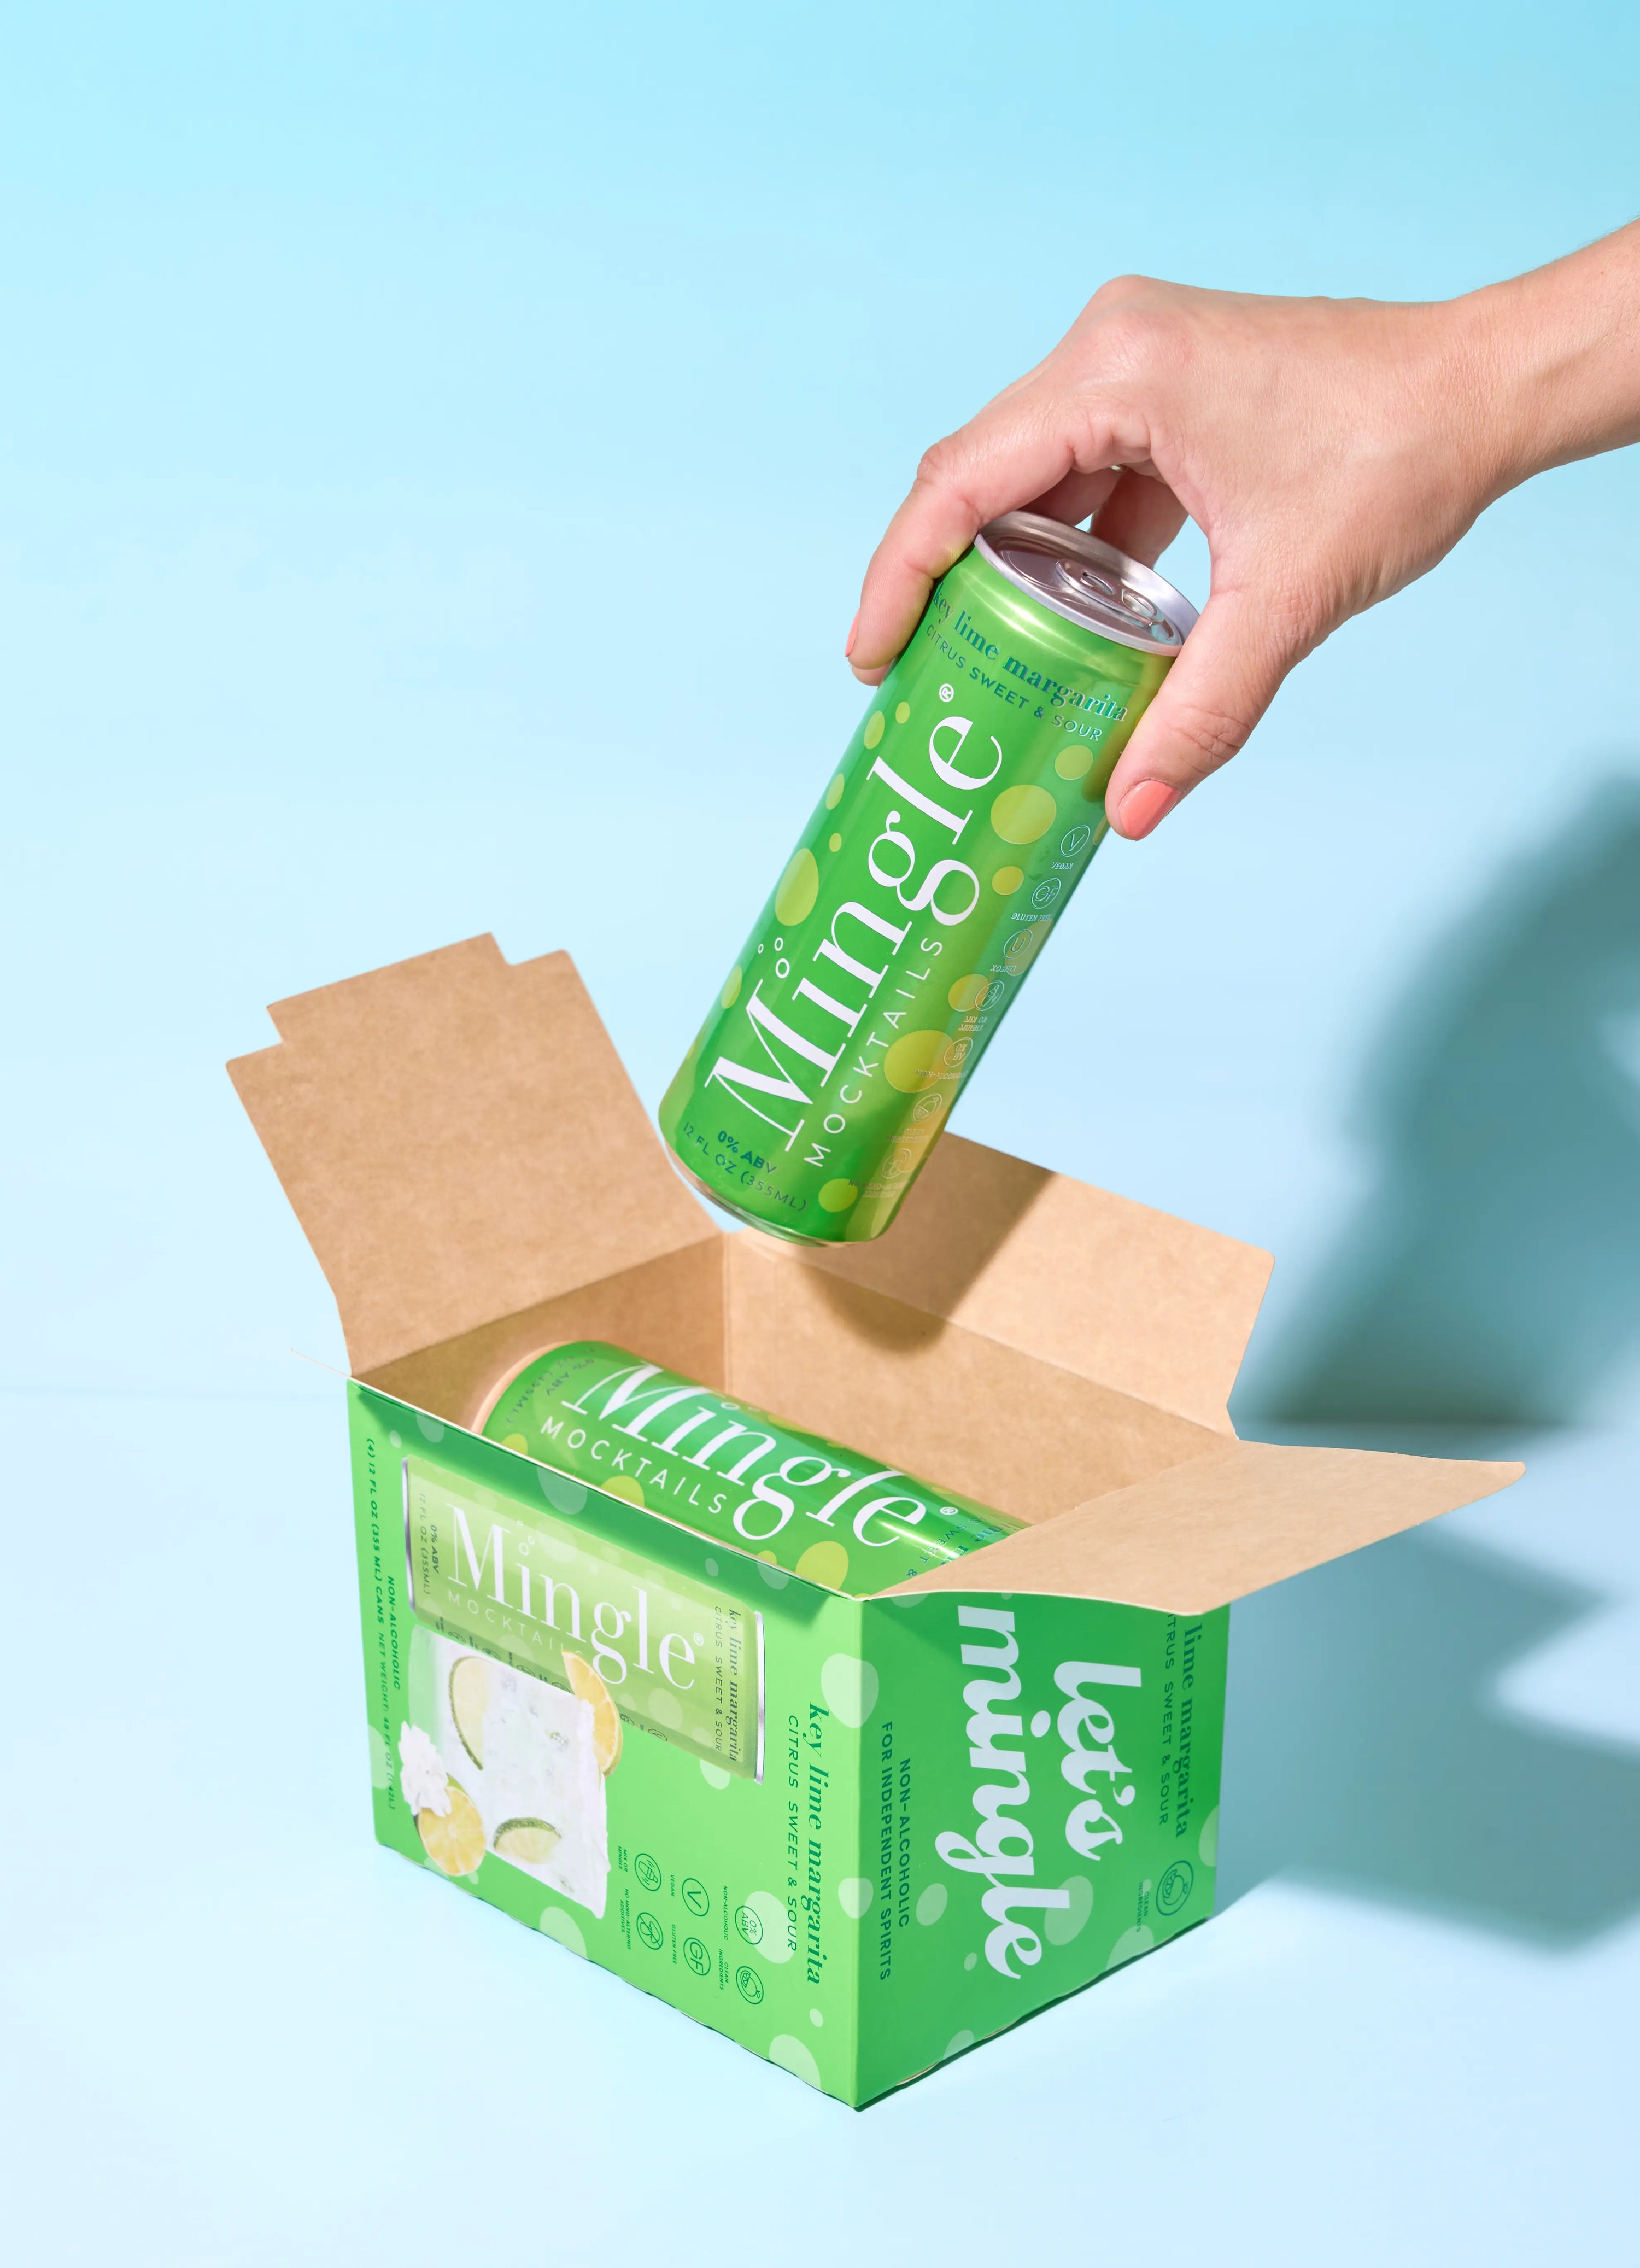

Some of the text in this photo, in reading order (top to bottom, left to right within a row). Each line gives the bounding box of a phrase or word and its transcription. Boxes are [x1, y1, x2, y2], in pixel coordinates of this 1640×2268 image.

[933, 581, 1128, 722] key lime margarita
[927, 624, 1103, 741] CITRUS SWEET & SOUR
[1051, 862, 1073, 870] VEGAN
[803, 937, 943, 1167] MOCKTAILS
[684, 1122, 807, 1212] 12 FL OZ (355ML)
[717, 1130, 778, 1174] 0% ABV
[367, 1438, 375, 1458] (4)
[369, 1463, 376, 1475] 12
[541, 1417, 727, 1513] MOCKTAILS
[370, 1479, 377, 1494] FL
[371, 1500, 378, 1519] OZ
[420, 1526, 427, 1544] OZ
[431, 1524, 437, 1542] 0%
[919, 1524, 967, 1564] SWEET
[374, 1556, 383, 1581] ML)
[906, 1569, 917, 1577] &
[376, 1586, 384, 1624] CANS
[448, 1589, 582, 1653] MOCKTAI
[387, 1575, 400, 1691] NON-ALCOHOLIC
[730, 1636, 741, 1675] lime
[725, 1680, 741, 1761] margarita
[1159, 1614, 1176, 1826] ITRUS SWEET & SOUR
[1173, 1622, 1203, 1838] lime margarita
[935, 1605, 1070, 1979] mingle
[787, 1715, 798, 1951] CITRUS SWEET & SOUR
[801, 1702, 829, 1984] key lime margarita
[880, 1721, 893, 1980] FOR INDEPENDENT SPIRITS
[898, 1758, 911, 1927] NON-ALCOHOLIC
[749, 1920, 757, 1936] 0%
[690, 1942, 704, 1973] GF
